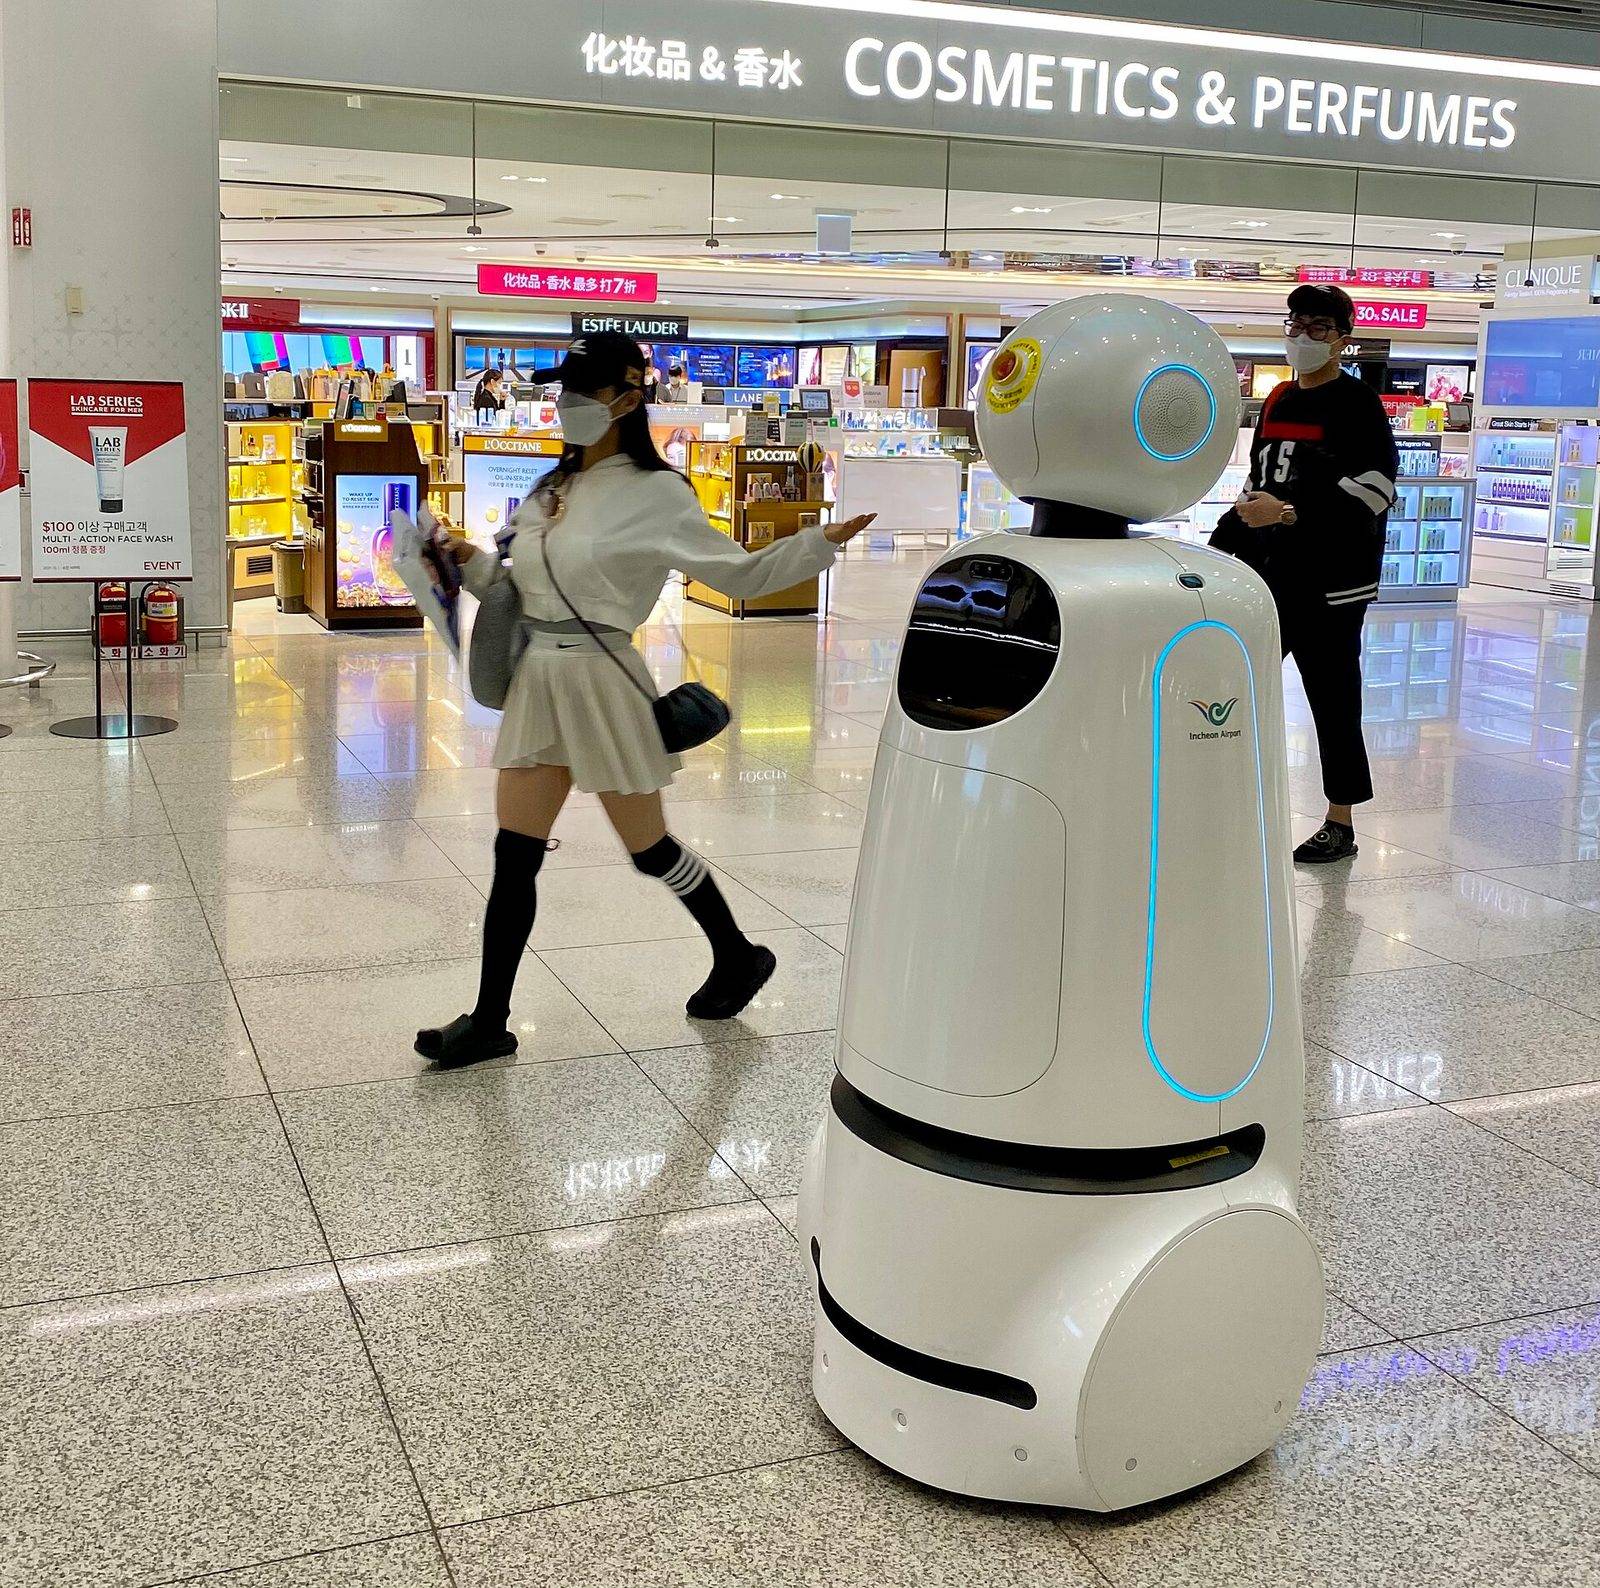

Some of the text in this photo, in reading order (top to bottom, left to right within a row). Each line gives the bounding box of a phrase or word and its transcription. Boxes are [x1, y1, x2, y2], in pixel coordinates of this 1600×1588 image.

[580, 31, 803, 90] 化妆品 & 香水
[844, 37, 1518, 149] COSMETICS & PERFUMES
[1505, 265, 1582, 289] CLINIQUE
[1356, 306, 1419, 323] 30% SALE
[625, 320, 679, 335] LAUDER
[70, 395, 143, 407] LAB SERIES
[1382, 401, 1417, 410] ERFUMES
[95, 436, 121, 447] LAB
[484, 438, 542, 452] L'OCCITANE
[746, 448, 798, 461] L'OCCITA
[42, 521, 148, 534] $100 이상 구매고객
[42, 535, 71, 543] MULTI
[79, 535, 115, 543] ACTION
[117, 535, 142, 543] FACE
[144, 535, 174, 543] WASH
[42, 546, 70, 554] 100ml
[71, 545, 88, 554] 정품
[143, 561, 182, 571] EVENT
[1189, 730, 1241, 740] Incheon Airport
